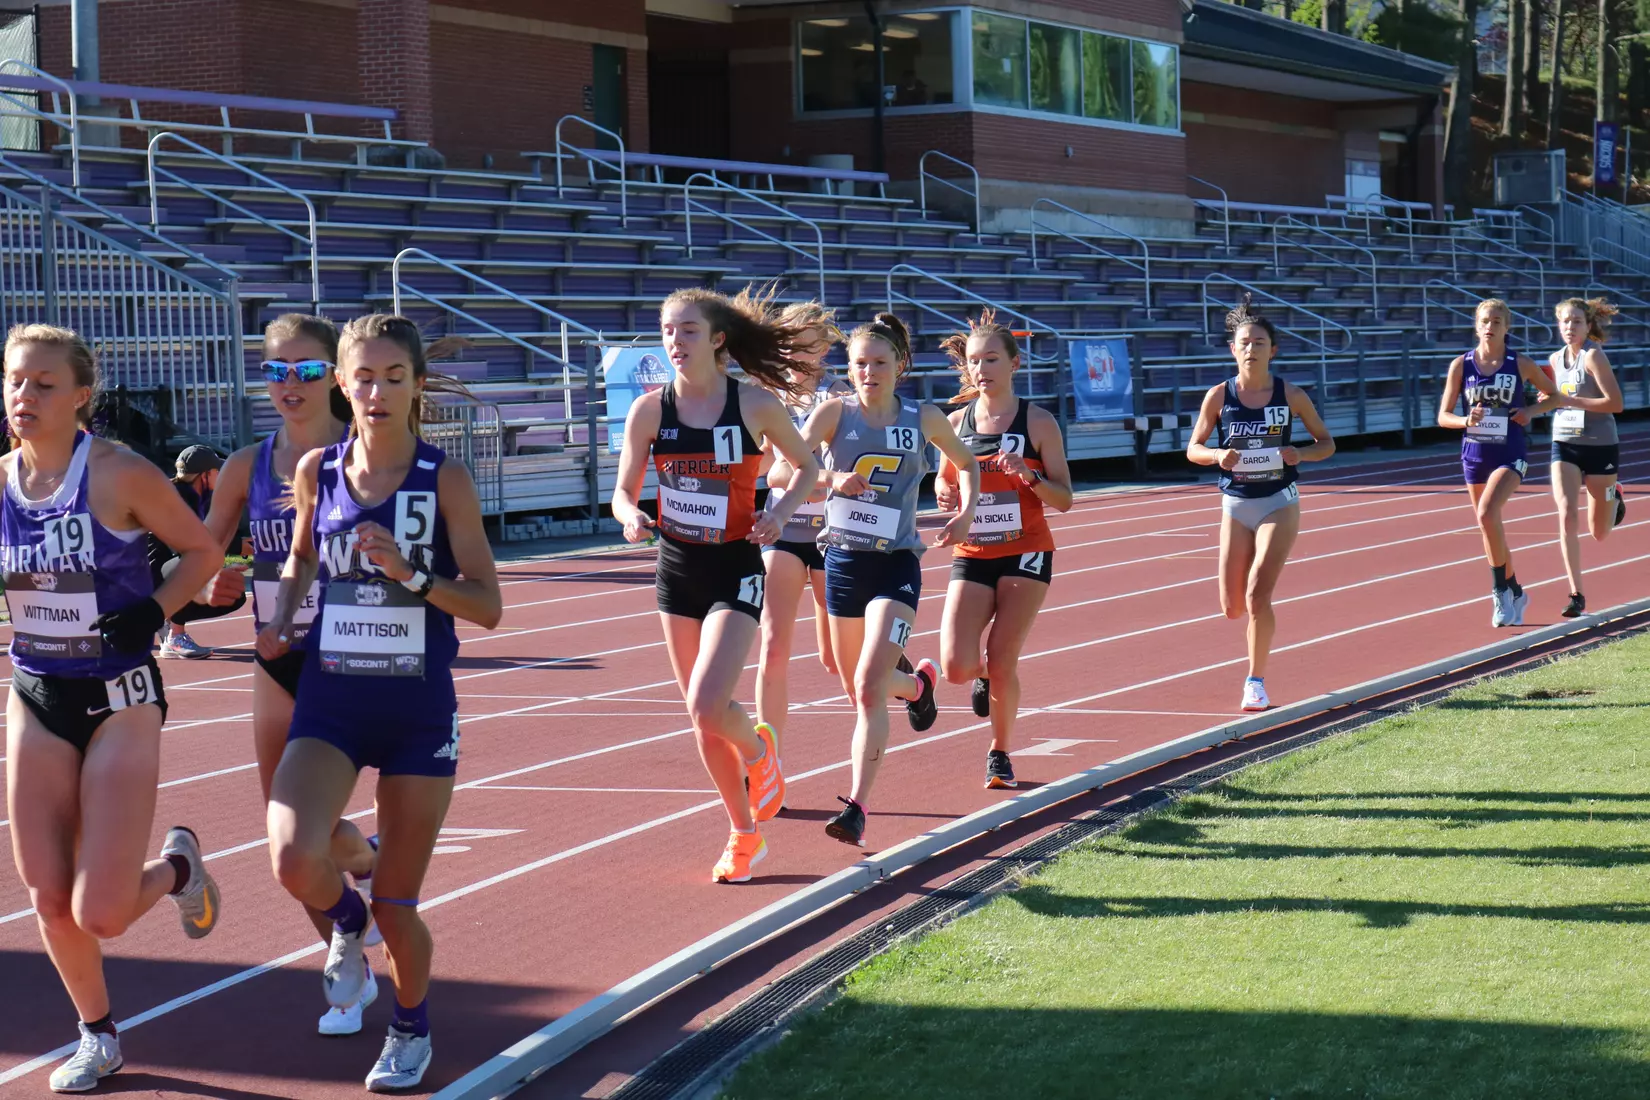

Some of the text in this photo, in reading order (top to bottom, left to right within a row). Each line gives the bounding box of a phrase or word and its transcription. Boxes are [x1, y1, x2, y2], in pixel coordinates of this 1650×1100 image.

[1499, 375, 1513, 389] 13
[1268, 407, 1286, 425] 15
[891, 427, 914, 451] 18
[1229, 421, 1283, 438] UNCG
[721, 428, 735, 462] 1
[1005, 435, 1021, 454] 2
[665, 459, 730, 475] MERCER
[1242, 456, 1271, 465] GARCIA
[666, 497, 717, 517] MCMAHON
[404, 494, 428, 542] 5
[848, 510, 878, 525] JONES
[984, 512, 1014, 524] SICKLE
[51, 517, 84, 555] 19
[249, 518, 298, 555] FUR
[1024, 552, 1040, 572] 2
[23, 604, 80, 622] WITTMAN
[334, 621, 409, 638] MATTISON
[897, 622, 912, 649] 18
[115, 669, 148, 707] 19
